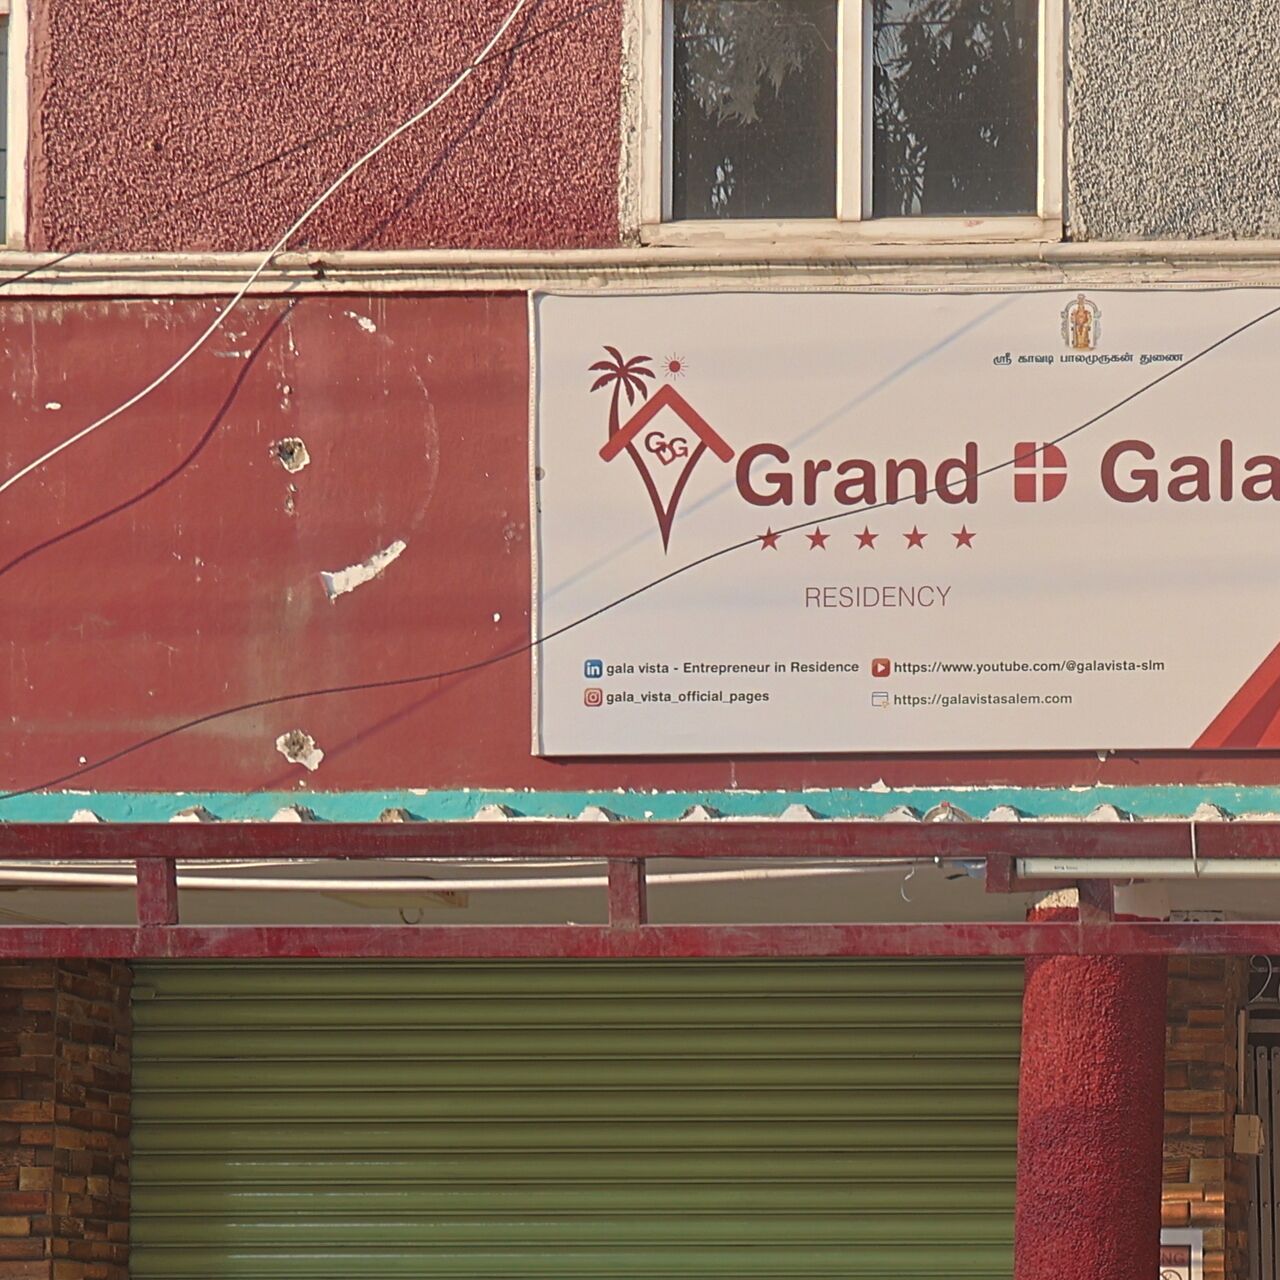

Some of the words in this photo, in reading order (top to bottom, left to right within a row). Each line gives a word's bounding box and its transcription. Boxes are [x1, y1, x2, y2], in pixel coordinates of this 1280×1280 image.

[1018, 355, 1054, 365] காவடி
[1060, 352, 1133, 365] பாலமுருகன்
[1140, 353, 1184, 365] துணை
[735, 441, 979, 506] Grand
[804, 585, 952, 609] RESIDENCY
[606, 662, 635, 676] gala
[638, 662, 670, 674] vista
[683, 661, 770, 675] Entrepreneur
[774, 661, 786, 673] in
[790, 660, 860, 673] Residence
[893, 659, 1165, 675] https://www.youtube.com/@galavista-slm
[606, 689, 770, 706] gala_vista_official_pages
[893, 692, 1073, 708] https://galavistasalem.com
